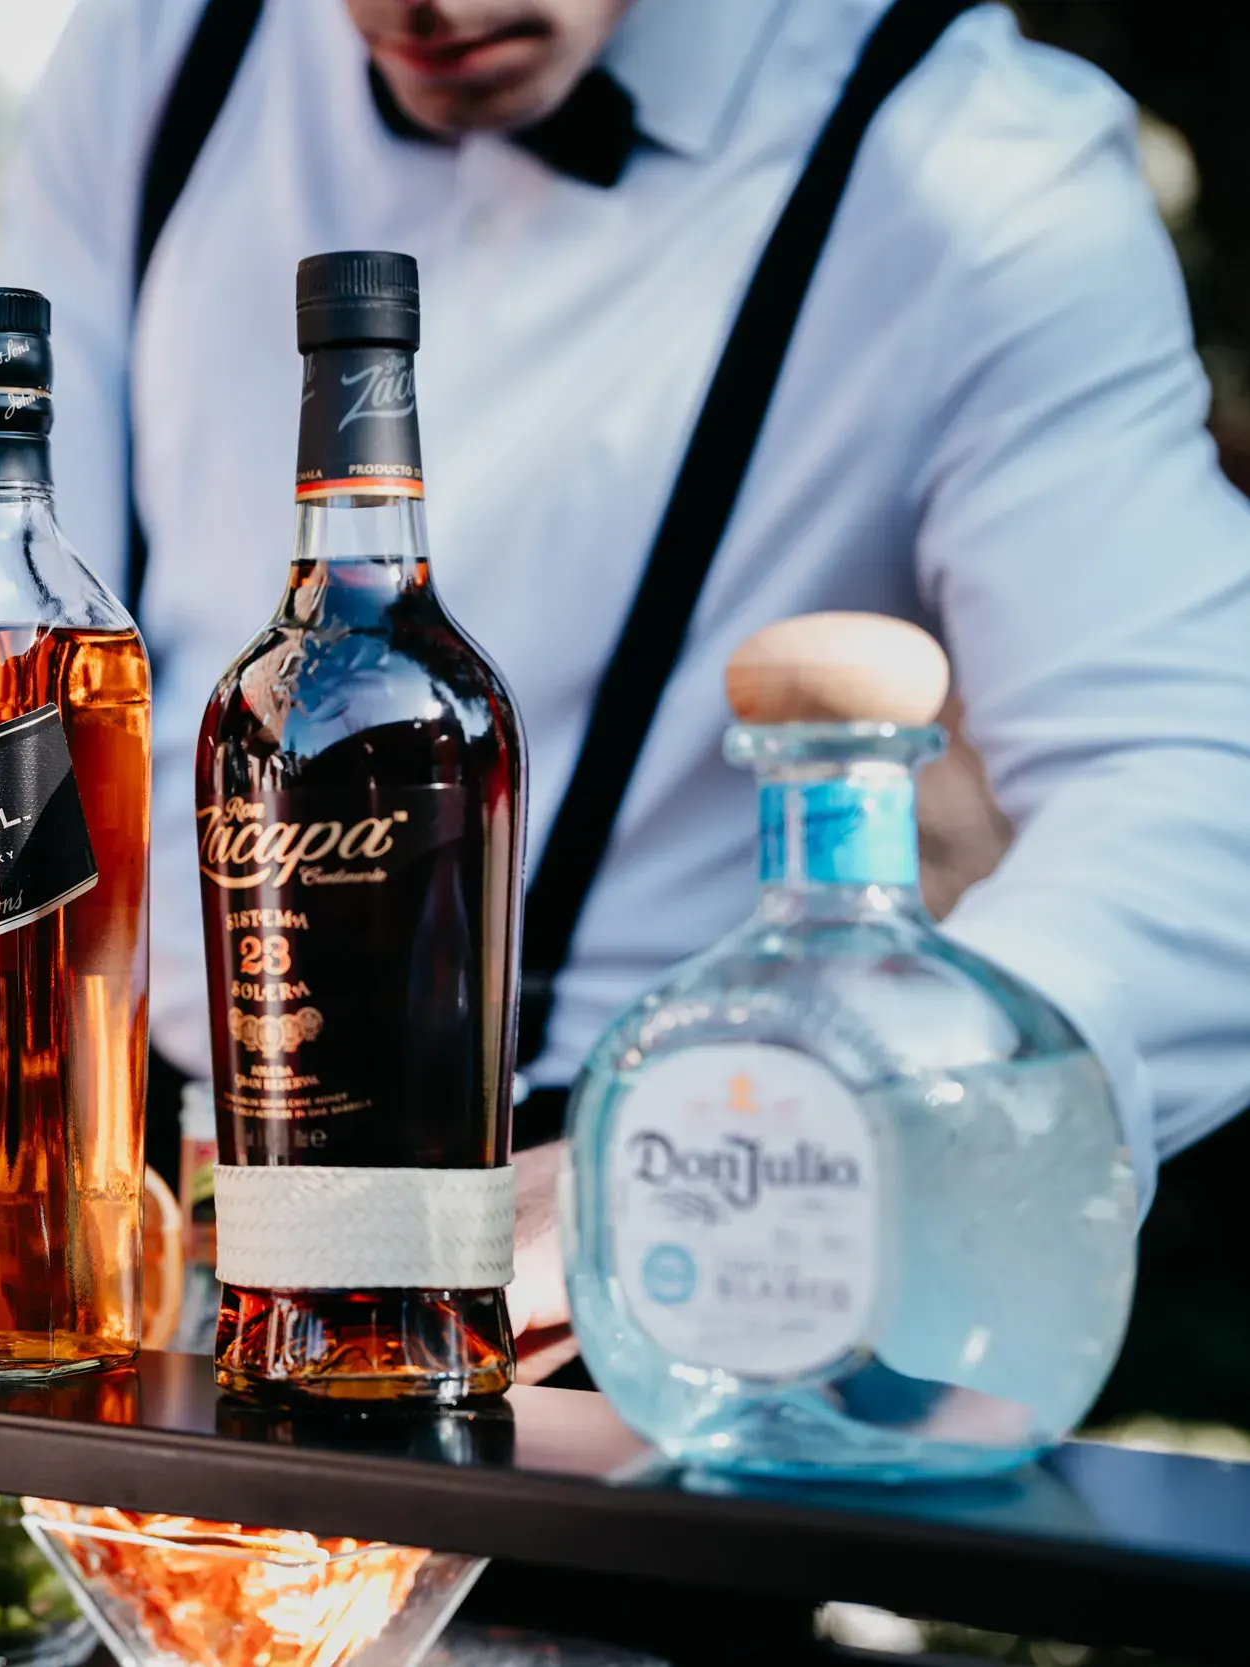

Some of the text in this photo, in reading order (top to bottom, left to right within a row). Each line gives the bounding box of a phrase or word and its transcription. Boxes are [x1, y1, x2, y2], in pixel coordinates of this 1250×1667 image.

[4, 339, 30, 363] Sons
[348, 463, 413, 477] PRODUCTO
[225, 908, 310, 932] SISTEMA
[238, 934, 292, 976] 23
[231, 980, 312, 1003] SOLERA
